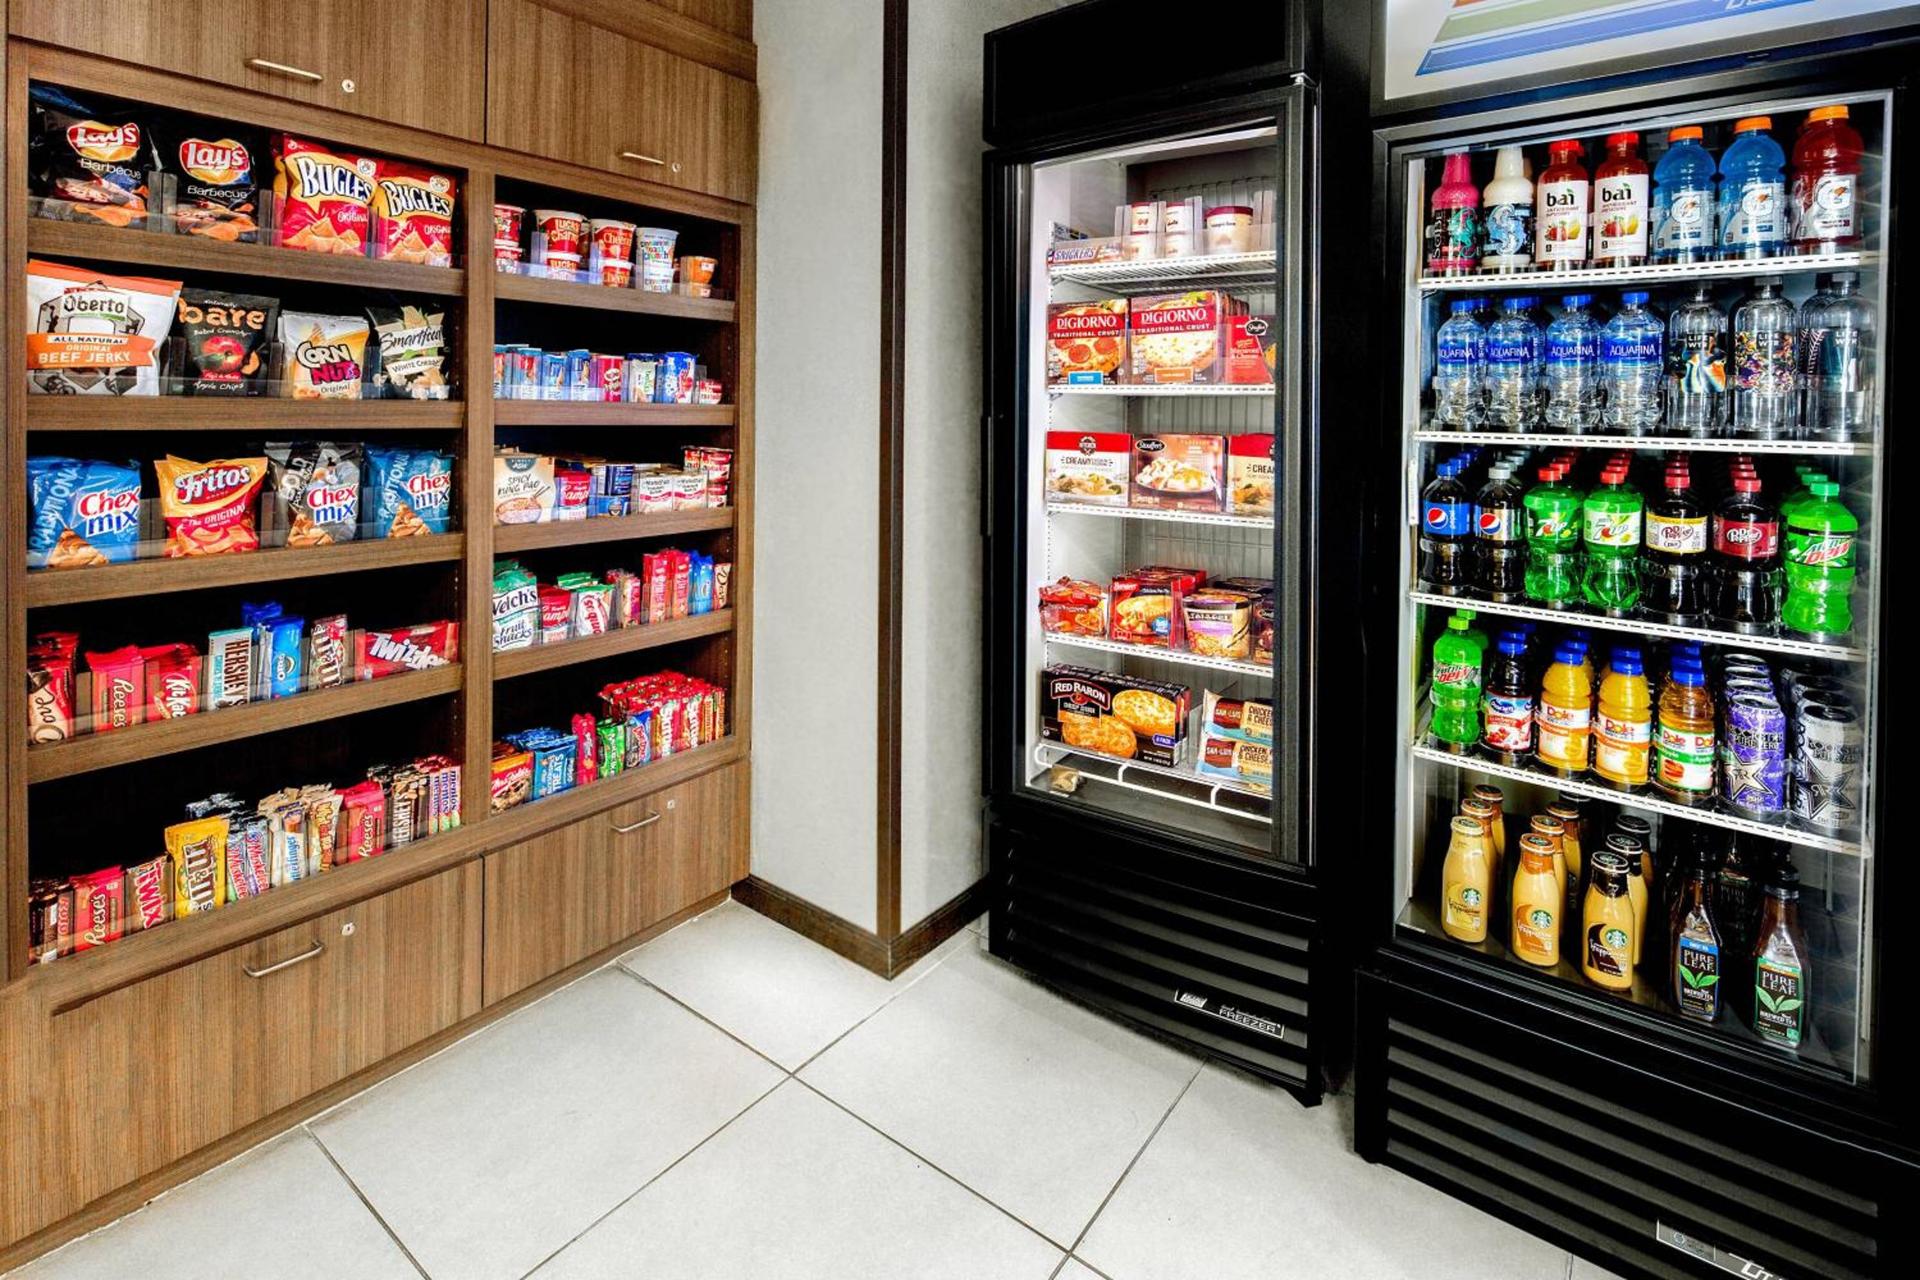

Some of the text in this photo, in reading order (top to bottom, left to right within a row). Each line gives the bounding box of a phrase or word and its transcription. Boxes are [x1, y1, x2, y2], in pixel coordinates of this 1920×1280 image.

[80, 158, 142, 180] Barbecue
[296, 157, 373, 202] BUGLES
[187, 185, 248, 199] Barbecue
[381, 181, 450, 217] BUGLES
[1546, 190, 1575, 207] bai
[1602, 184, 1632, 203] bai
[1055, 249, 1095, 261] SNICKERS
[64, 295, 125, 314] Oberto
[178, 297, 265, 330] bare
[1137, 323, 1211, 335] TRADITIONAL CRUST
[38, 351, 130, 364] BEEF JERKY
[296, 341, 353, 369] CORN
[1490, 346, 1530, 359] AQUAFINA
[1551, 345, 1595, 357] AQUAFINA
[1609, 344, 1657, 357] AQUAFINA
[310, 360, 360, 386] NUTS
[320, 383, 351, 394] Original
[175, 466, 251, 504] Fritos
[409, 472, 451, 494] Chex
[78, 488, 141, 517] Chex
[308, 485, 357, 508] Chex
[414, 488, 450, 510] mix
[87, 508, 139, 537] mix
[315, 502, 356, 525] mix
[369, 632, 450, 670] Twizzle
[224, 640, 250, 708] HERSHEY'S
[1055, 682, 1105, 703] RED BARON
[1249, 705, 1272, 718] CHICKE
[1547, 706, 1575, 719] Dole
[1605, 718, 1635, 732] Dole
[1663, 730, 1686, 747] Dole
[441, 771, 449, 814] mentos
[1684, 949, 1714, 962] PURE
[1762, 971, 1796, 986] PURE
[1219, 1008, 1276, 1033] FREEZER
